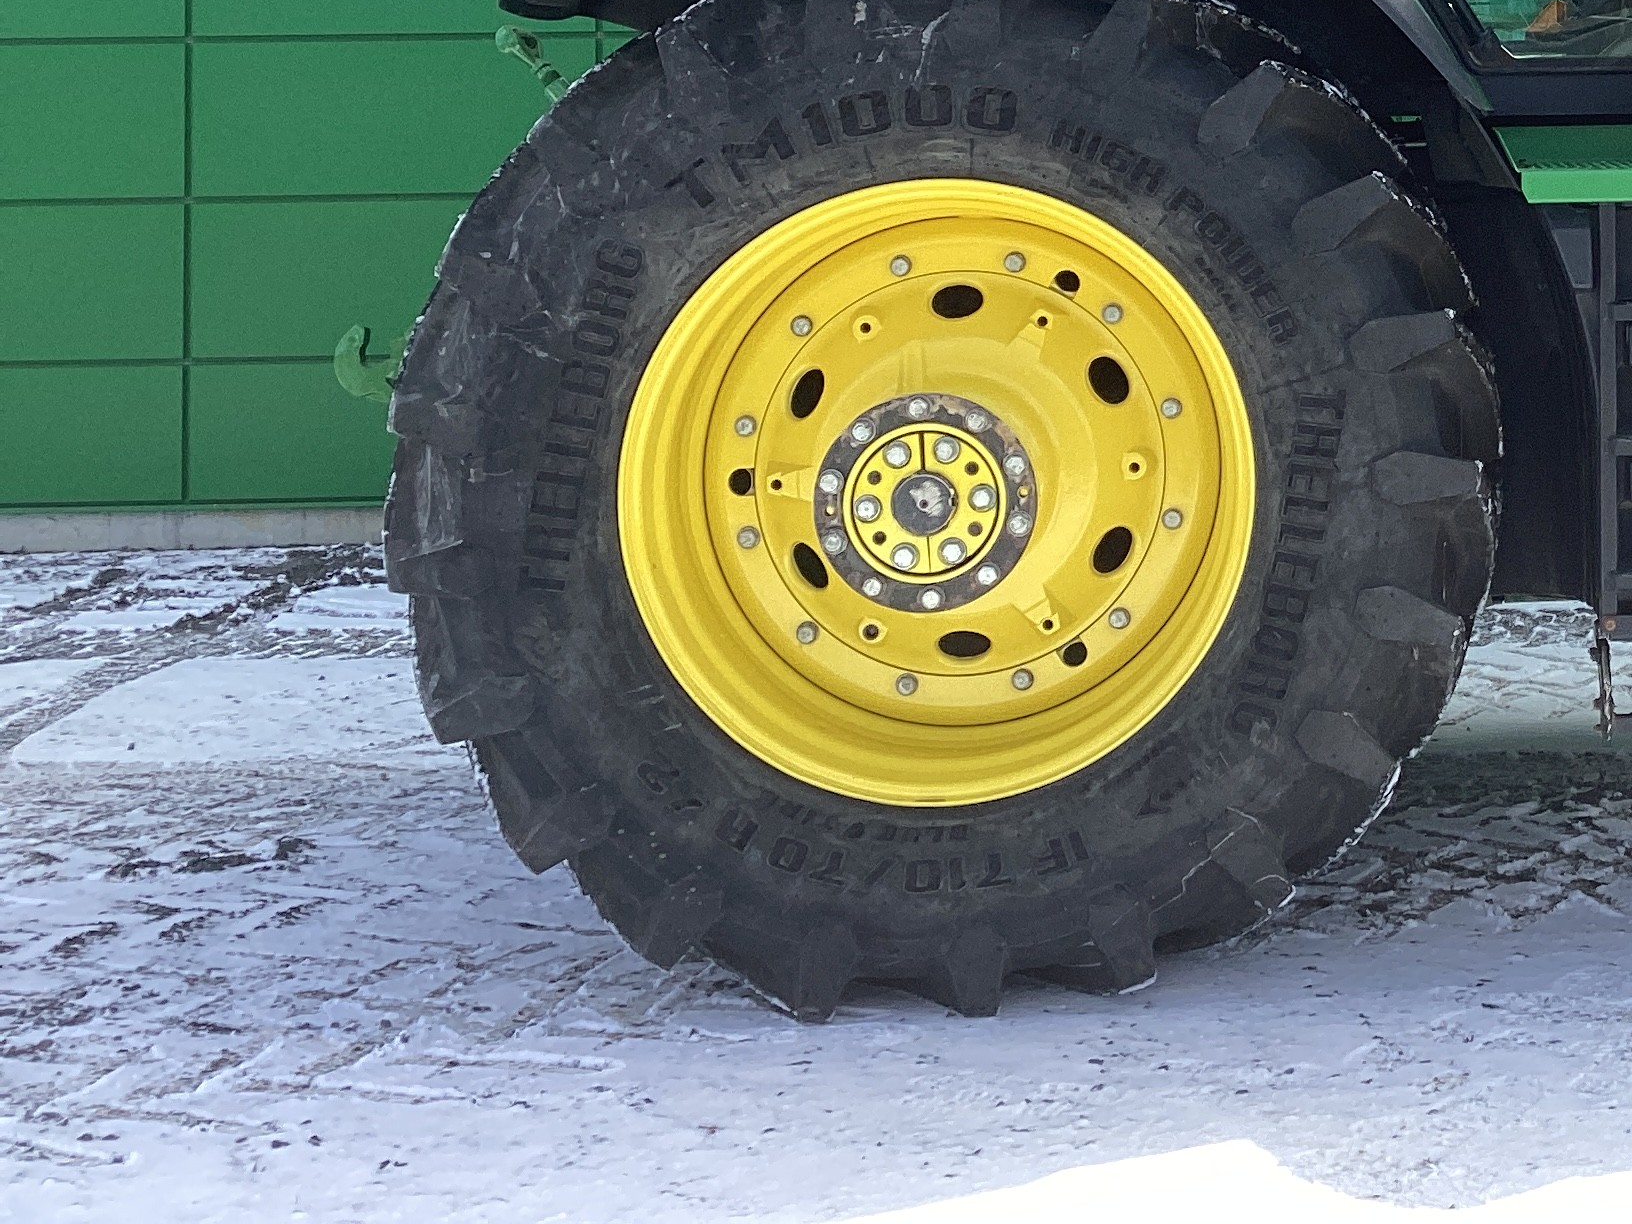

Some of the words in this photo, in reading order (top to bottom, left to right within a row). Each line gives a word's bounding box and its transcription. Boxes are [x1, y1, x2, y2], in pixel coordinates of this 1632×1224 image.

[664, 81, 1019, 210] TM1000
[1047, 118, 1170, 196] HIGH
[1162, 186, 1298, 346] POWER
[517, 237, 645, 597] TRELLEBORG
[1230, 386, 1348, 740] TRELLEBORG
